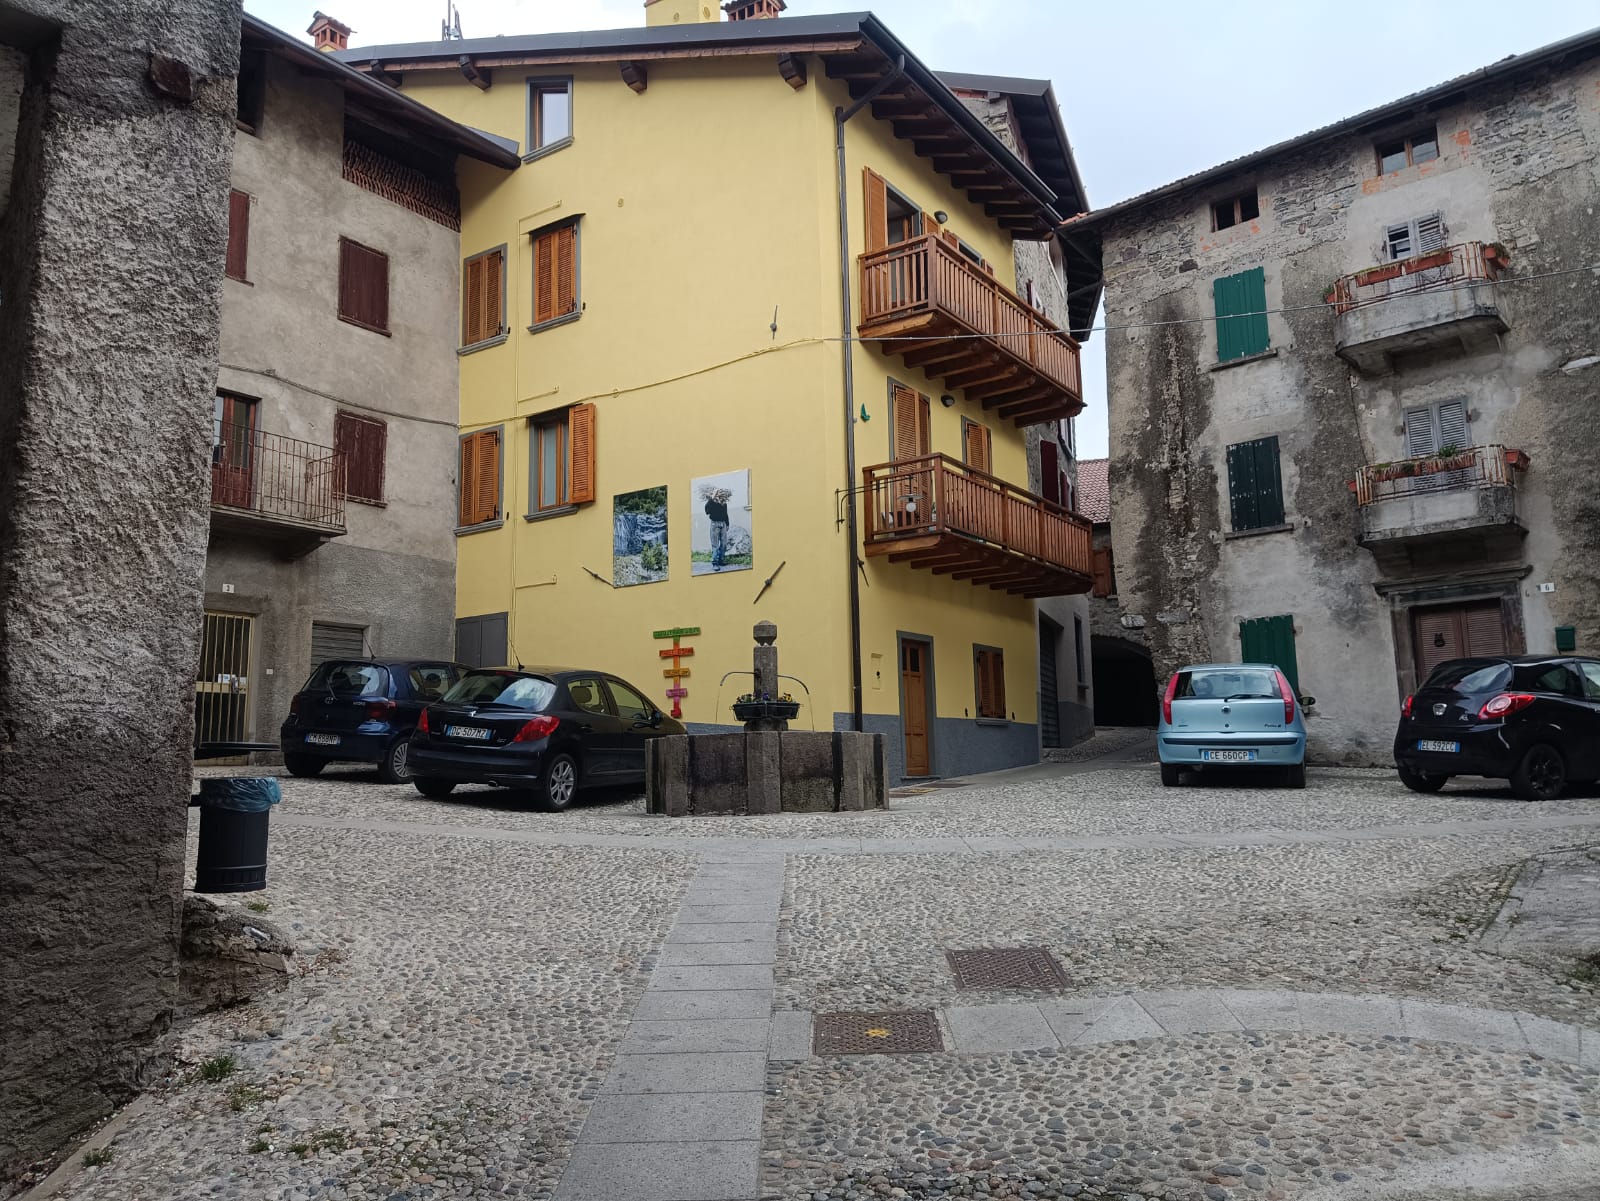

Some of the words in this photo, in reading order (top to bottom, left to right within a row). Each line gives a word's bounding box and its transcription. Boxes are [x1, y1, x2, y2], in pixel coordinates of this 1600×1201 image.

[1422, 740, 1430, 750] EL
[1210, 751, 1220, 760] CE
[1222, 751, 1248, 760] 660GP
